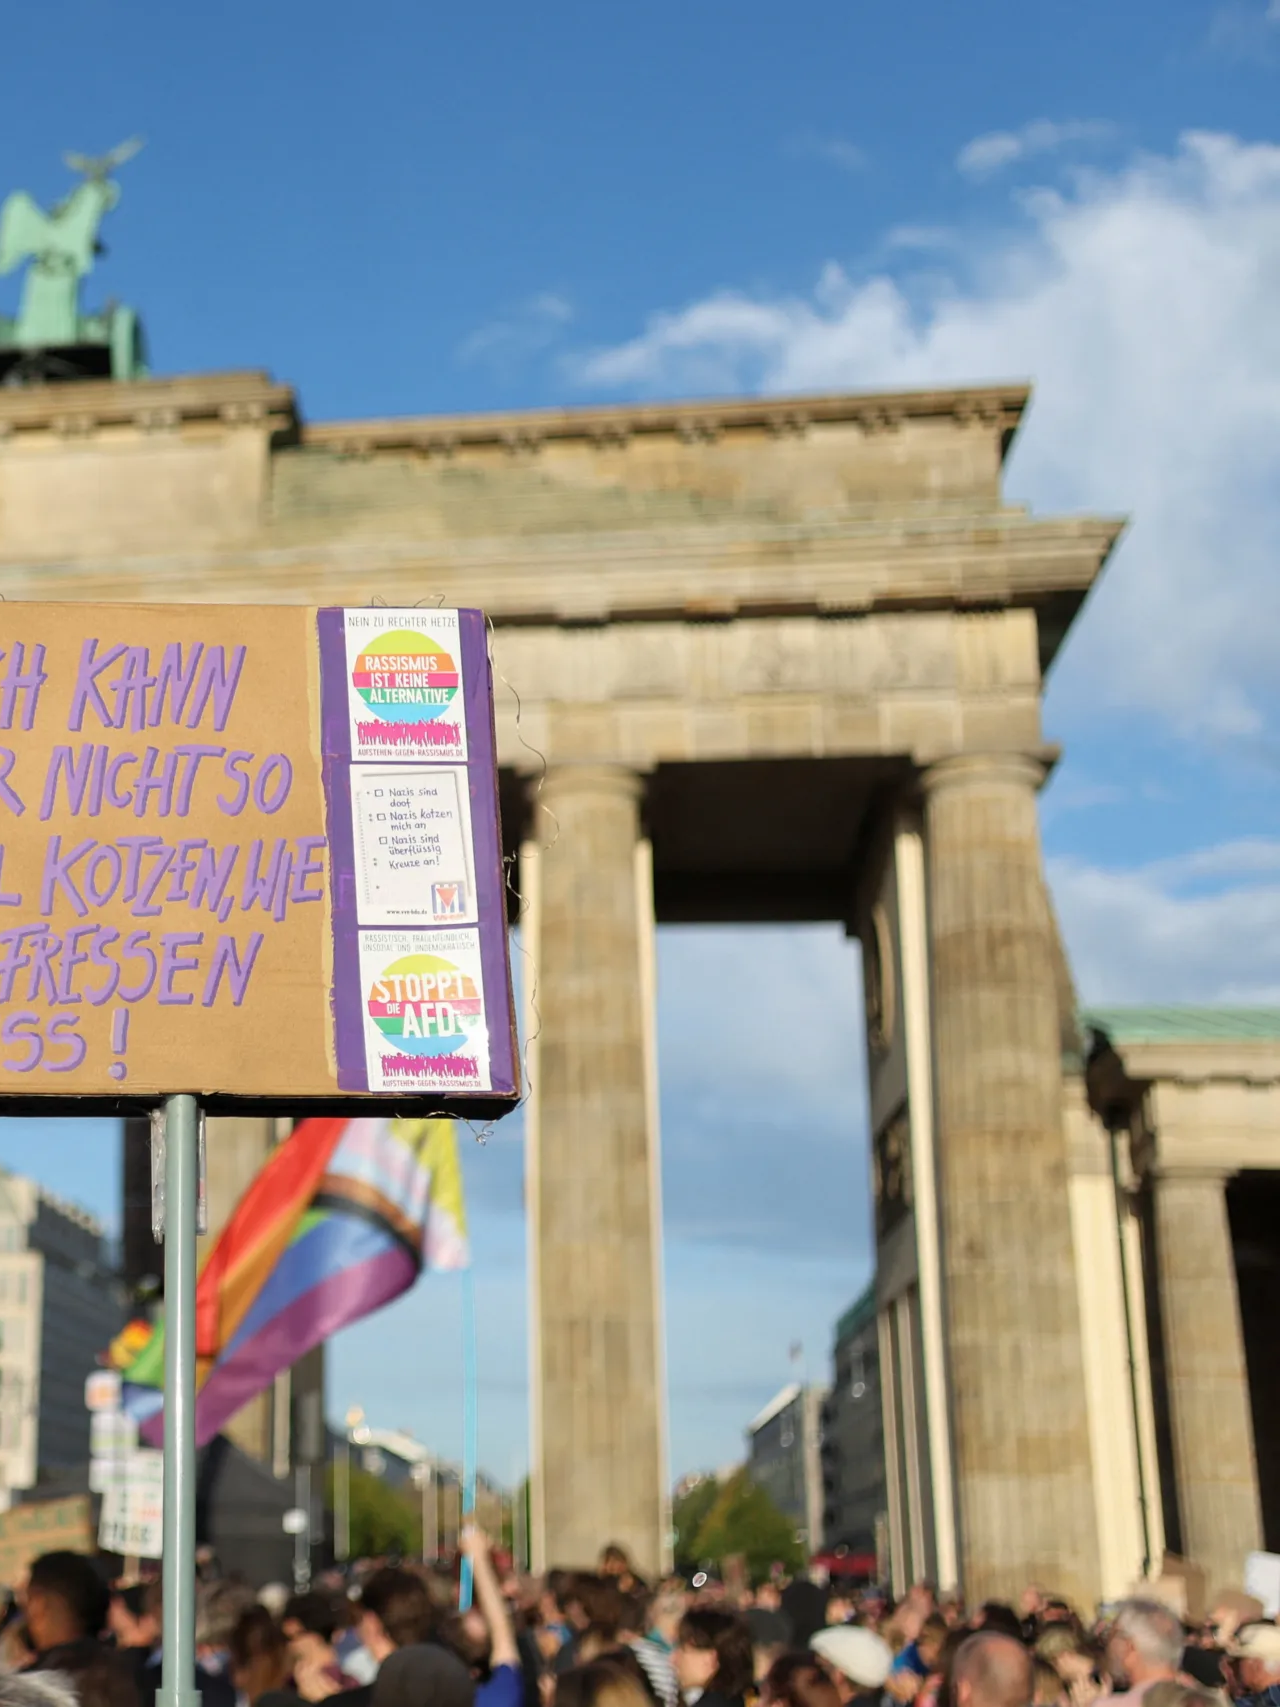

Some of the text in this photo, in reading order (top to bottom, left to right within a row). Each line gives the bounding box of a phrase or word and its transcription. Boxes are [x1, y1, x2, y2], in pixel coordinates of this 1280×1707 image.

[348, 616, 456, 628] NEIN ZU RECHTER HETZE
[365, 656, 438, 671] RASSISMUS
[67, 638, 246, 733] KANN
[371, 673, 429, 687] IST KEINE
[370, 688, 449, 704] ALTERNATIVE
[39, 743, 226, 822] NICHT
[215, 752, 293, 817] SO
[389, 788, 438, 797] Nazis sind
[390, 799, 411, 808] doof
[390, 808, 453, 821] Nazis kotzen
[391, 820, 426, 831] mich an
[392, 834, 440, 845] Nazis sind
[389, 845, 442, 856] überflüssig
[389, 856, 440, 870] Kreuze an!
[239, 836, 328, 922] WIE
[397, 944, 411, 952] UND
[375, 971, 465, 1003] STOPPT
[386, 1002, 456, 1039] DIE AFD
